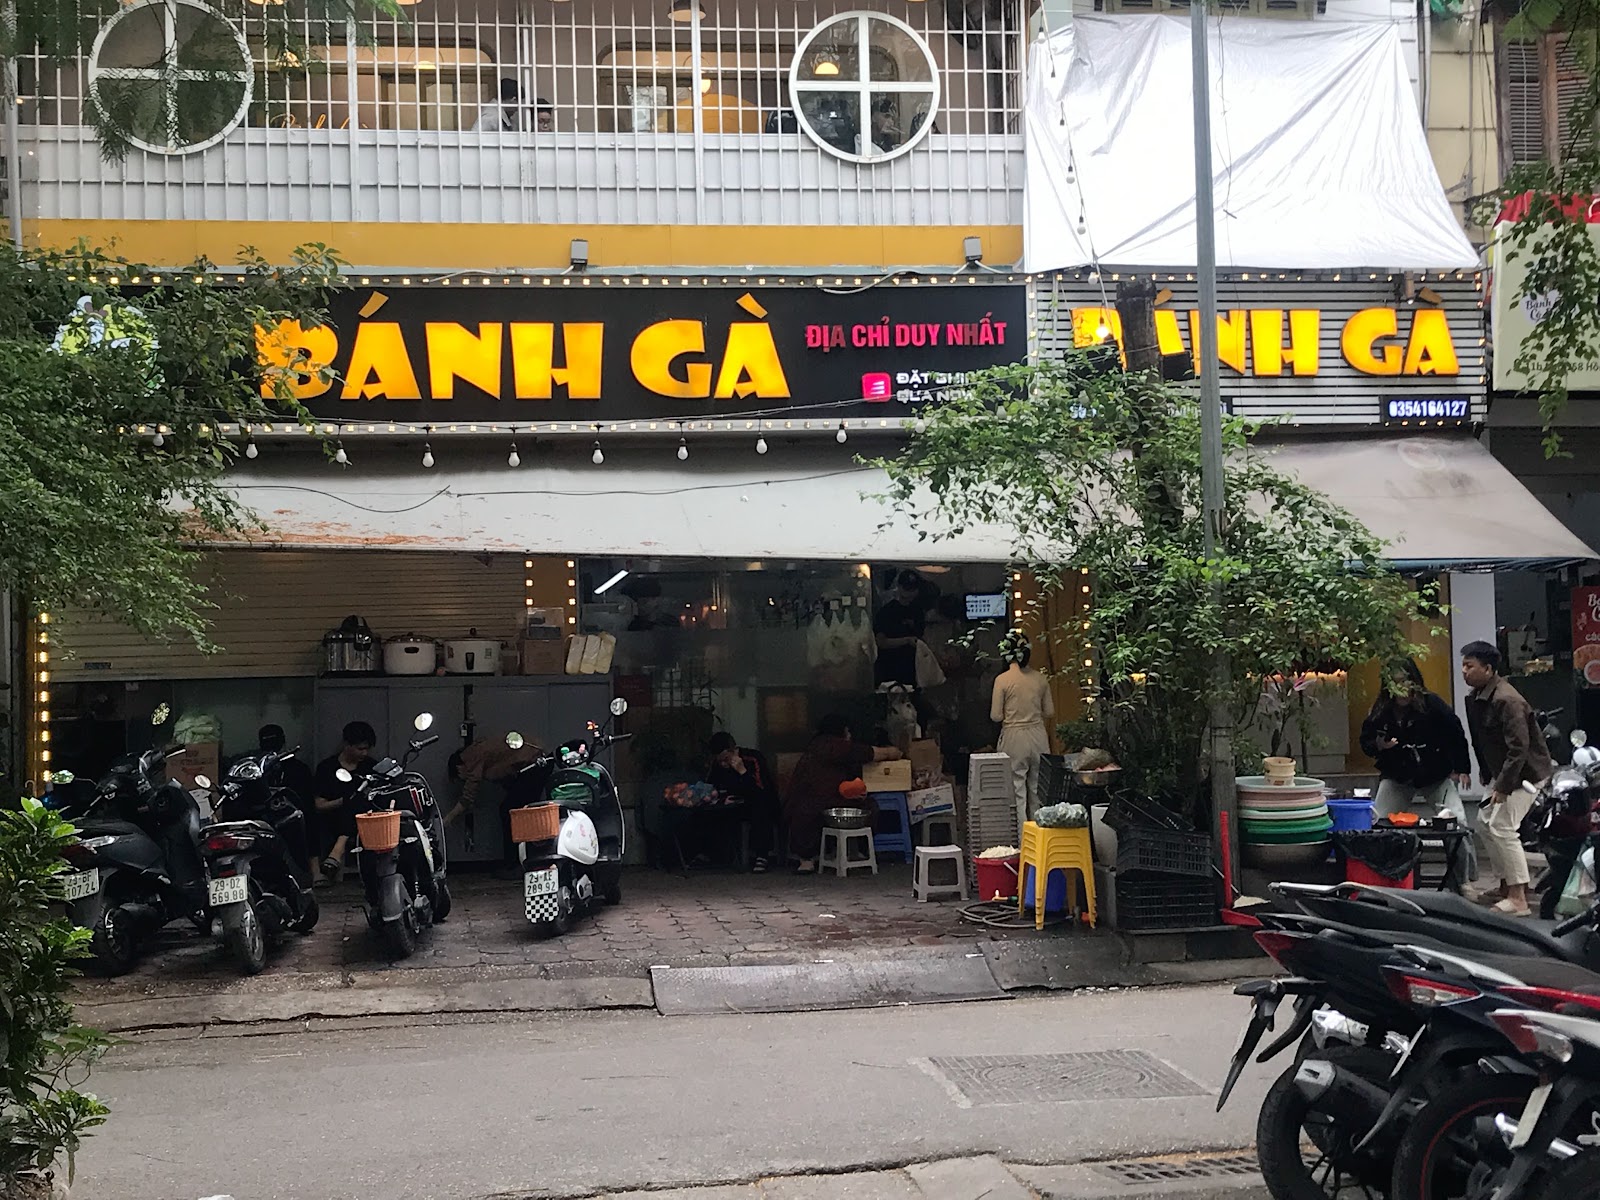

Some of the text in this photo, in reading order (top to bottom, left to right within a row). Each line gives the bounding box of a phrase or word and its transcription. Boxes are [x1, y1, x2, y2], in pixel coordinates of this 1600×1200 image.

[253, 290, 791, 400] BÁNH GÀ
[805, 311, 1007, 352] ĐỊA CHỈ DUY NHẤT
[1341, 286, 1460, 376] GÀ
[896, 369, 928, 388] ĐẶT
[1389, 400, 1468, 417] 0354164127
[211, 888, 245, 904] 569.88
